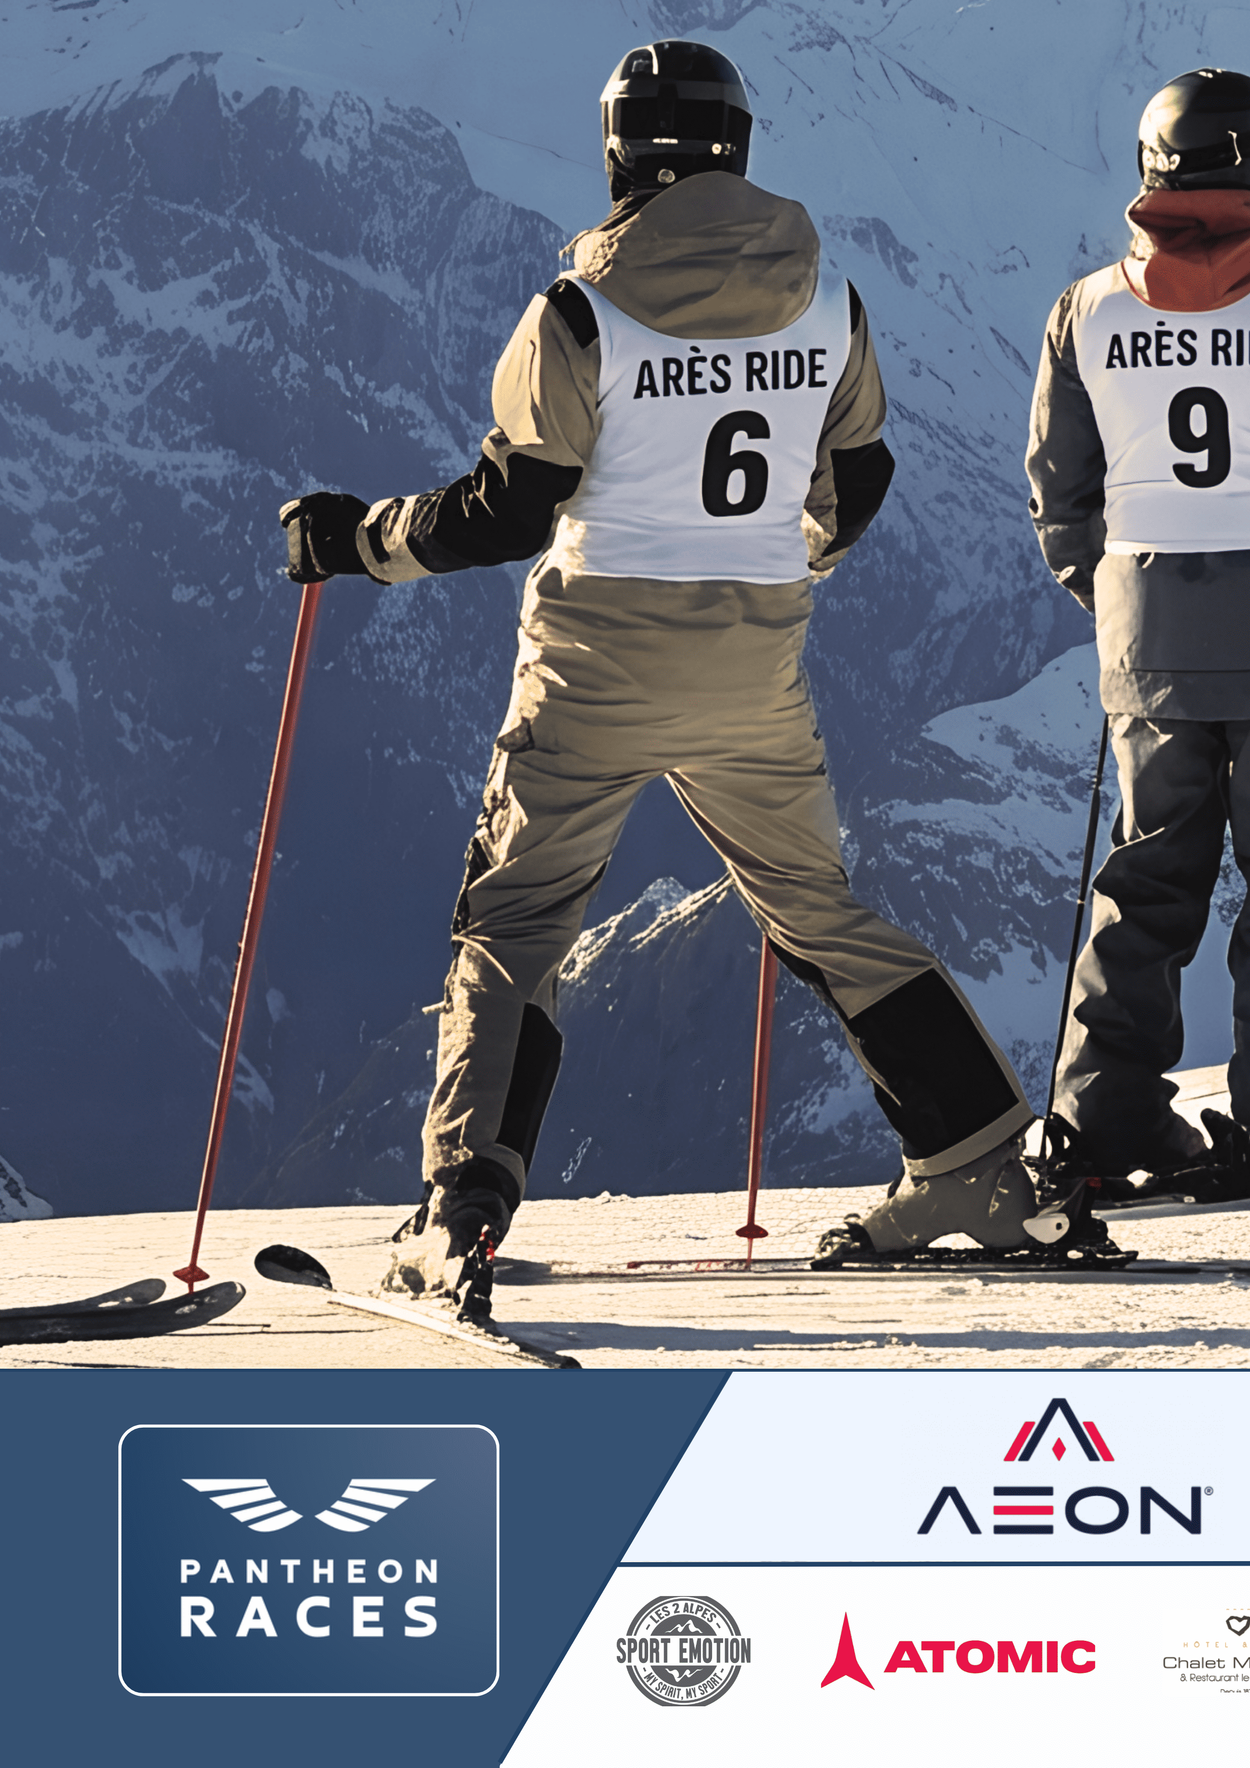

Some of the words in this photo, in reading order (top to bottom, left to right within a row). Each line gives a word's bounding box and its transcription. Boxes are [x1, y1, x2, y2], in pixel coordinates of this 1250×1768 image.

[633, 345, 732, 400] ARÈS
[746, 348, 828, 392] RIDE
[1167, 385, 1232, 489] 9
[701, 409, 772, 518] 6
[181, 1559, 437, 1583] PANTHEON
[181, 1596, 437, 1637] RACES
[650, 1605, 671, 1624] LES
[672, 1603, 680, 1613] 2
[683, 1602, 717, 1623] ALPES
[616, 1637, 671, 1664] SPORT
[679, 1637, 751, 1664] EMOTION
[884, 1640, 1095, 1674] ATOMIC
[1183, 1640, 1229, 1649] HÔTEL
[1242, 1641, 1248, 1649] &
[1163, 1657, 1225, 1669] Chalet
[643, 1672, 659, 1686] MY
[655, 1681, 684, 1700] SPIRIT,
[686, 1687, 697, 1699] MY
[698, 1672, 723, 1696] SPORT
[1180, 1673, 1188, 1683] &
[1190, 1673, 1240, 1683] Restaurant
[1241, 1673, 1250, 1683] le
